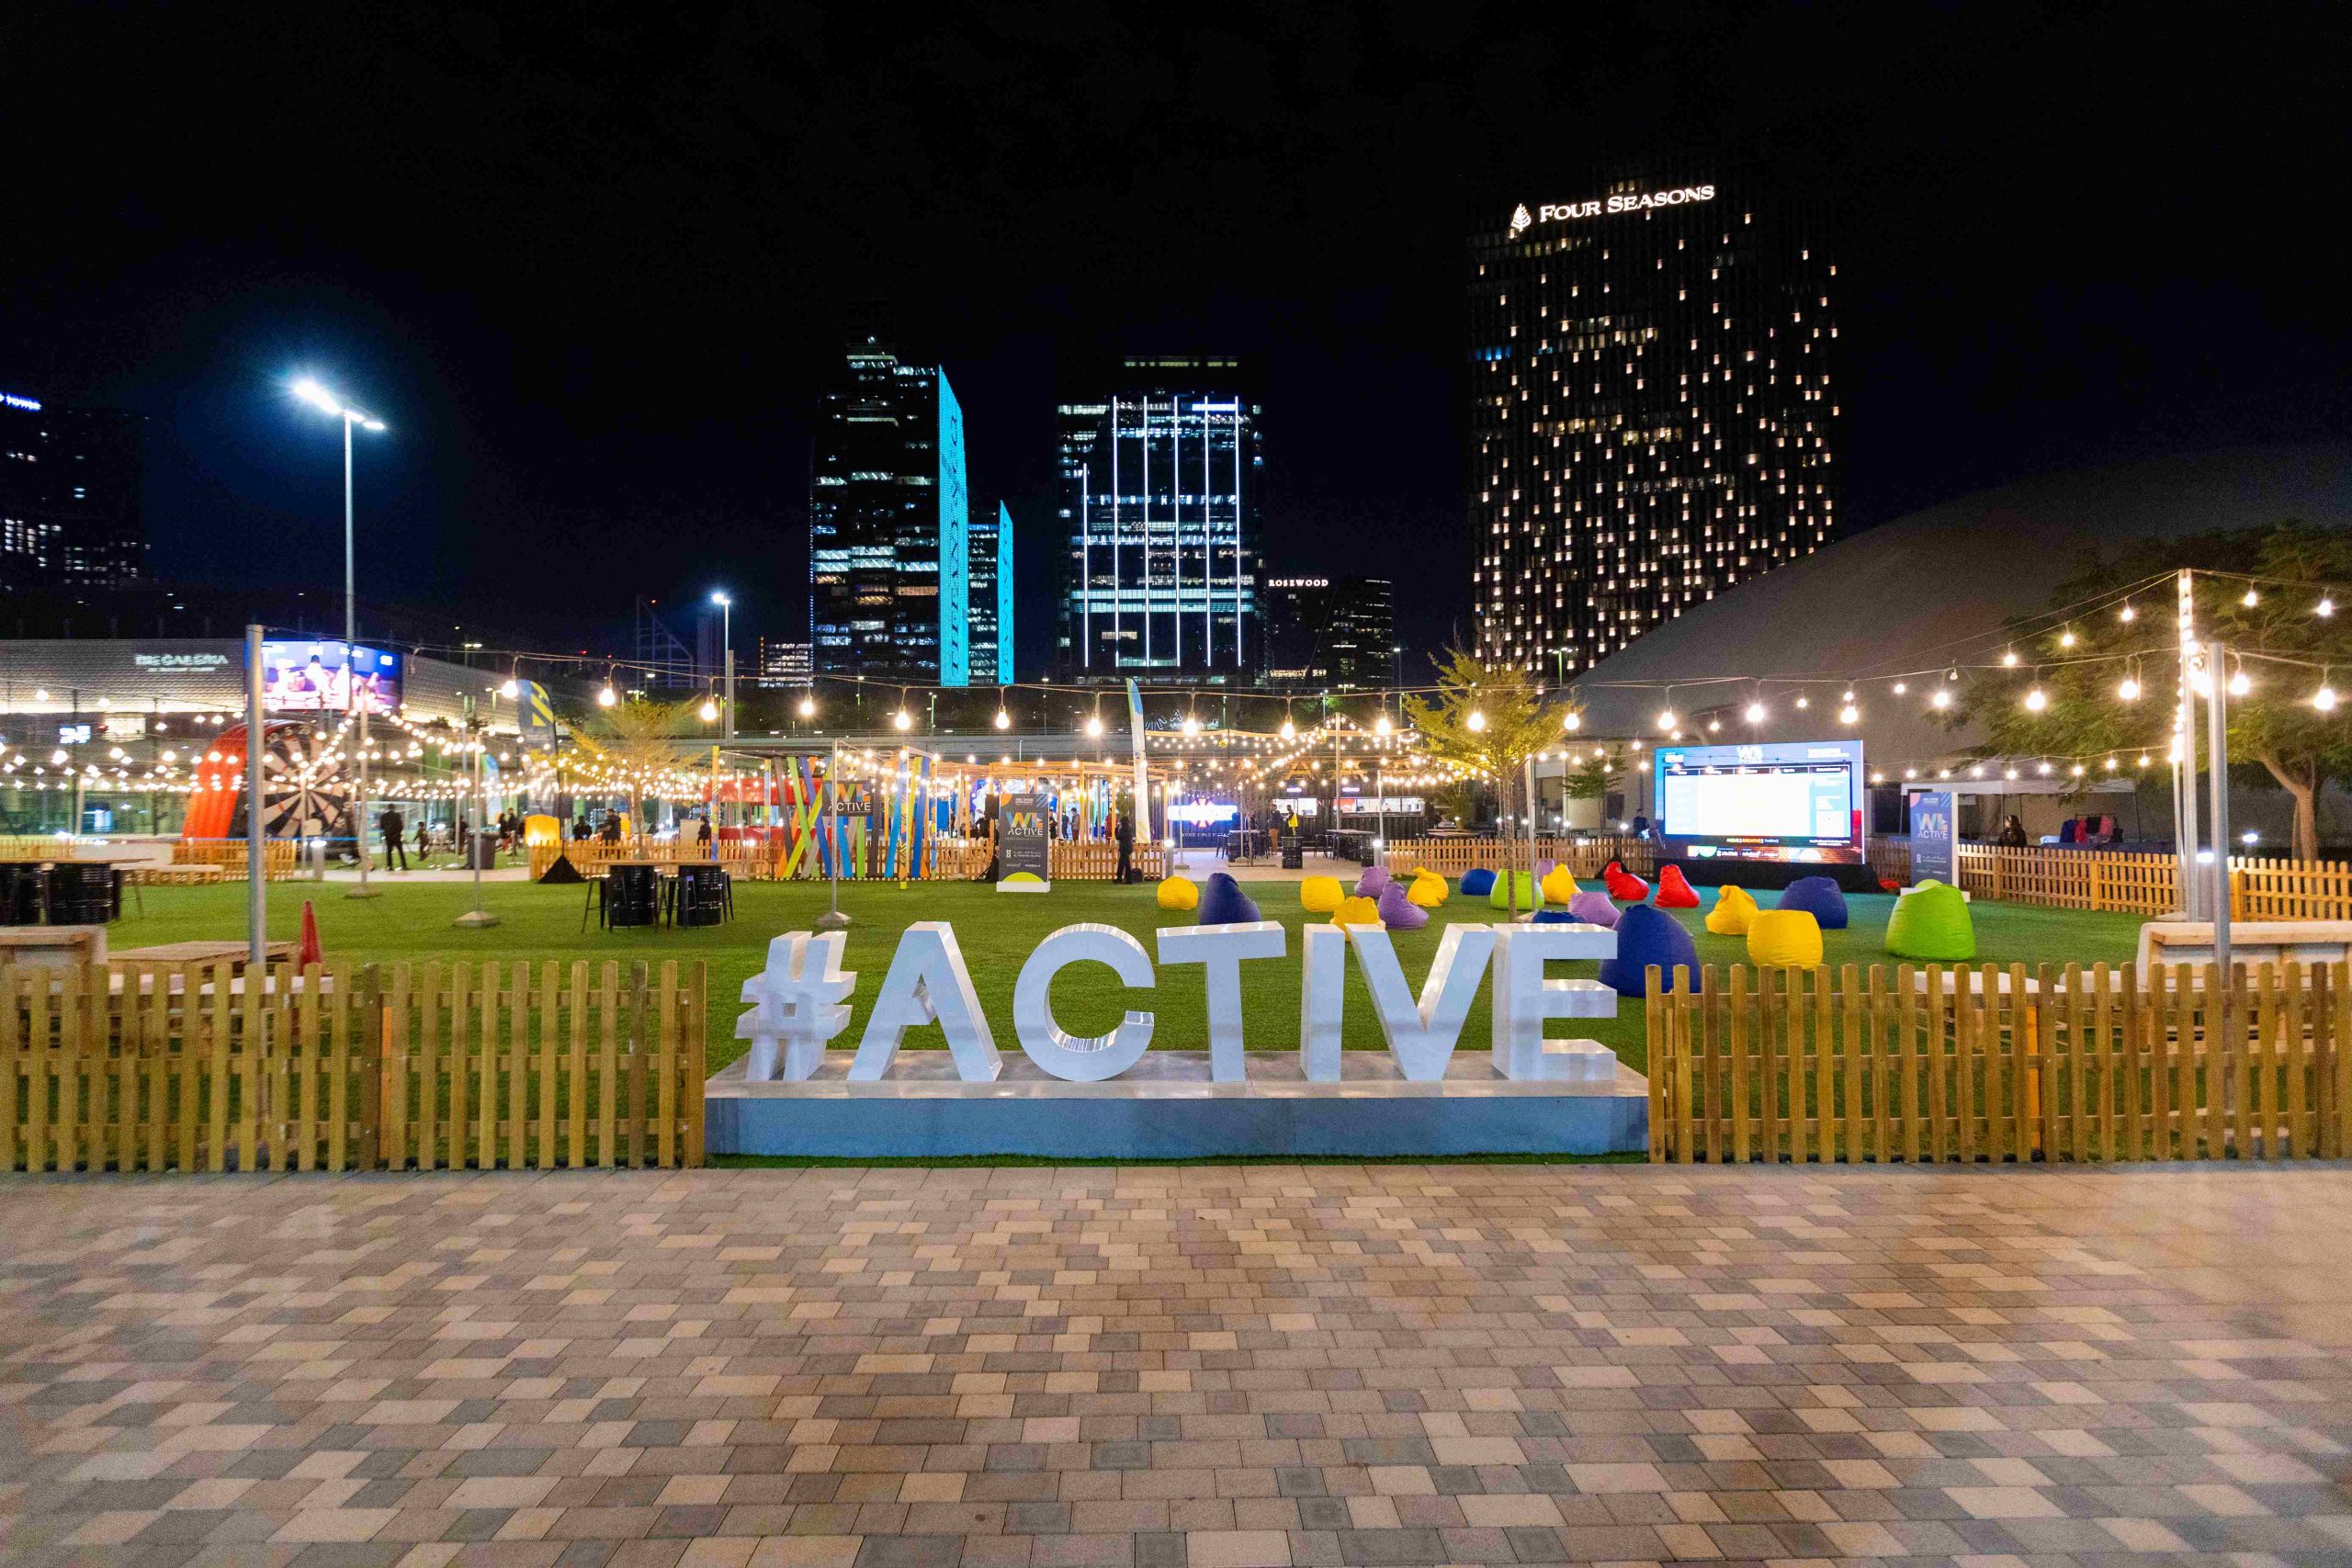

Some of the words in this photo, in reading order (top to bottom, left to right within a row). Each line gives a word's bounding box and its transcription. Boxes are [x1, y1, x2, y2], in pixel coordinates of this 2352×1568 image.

[1540, 200, 1601, 222] FOUR
[1608, 185, 1715, 213] SEASONS
[1269, 579, 1329, 587] ROSEWOOD
[1005, 812, 1043, 828] WE
[1008, 828, 1043, 836] ACTIVE
[1917, 830, 1948, 839] ACTIVE
[735, 920, 1618, 1084] #ACTIVE
